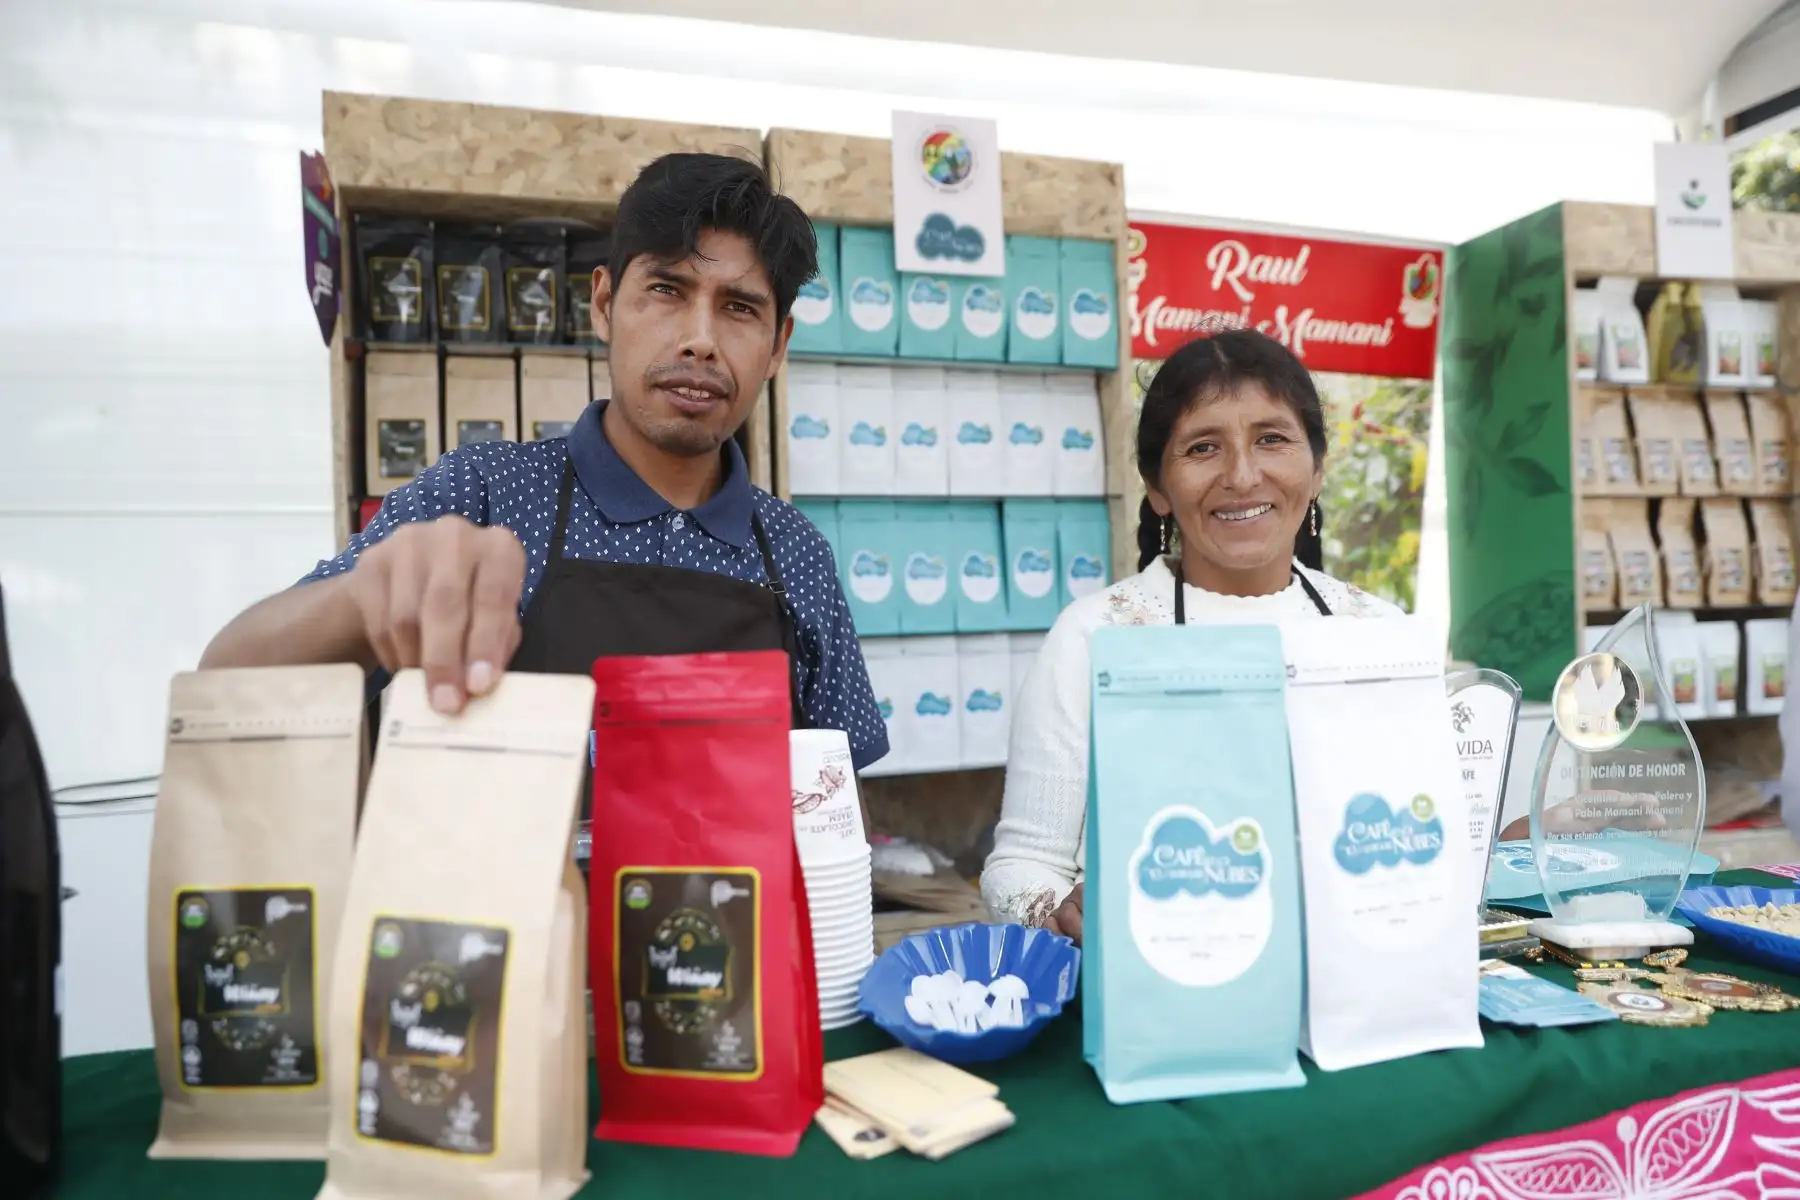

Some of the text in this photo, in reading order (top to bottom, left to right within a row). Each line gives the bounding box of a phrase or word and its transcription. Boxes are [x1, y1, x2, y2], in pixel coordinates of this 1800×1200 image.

[1206, 239, 1311, 302] Raul
[1256, 304, 1394, 358] Mamani
[1629, 764, 1644, 778] DE
[1646, 763, 1686, 778] HONOR
